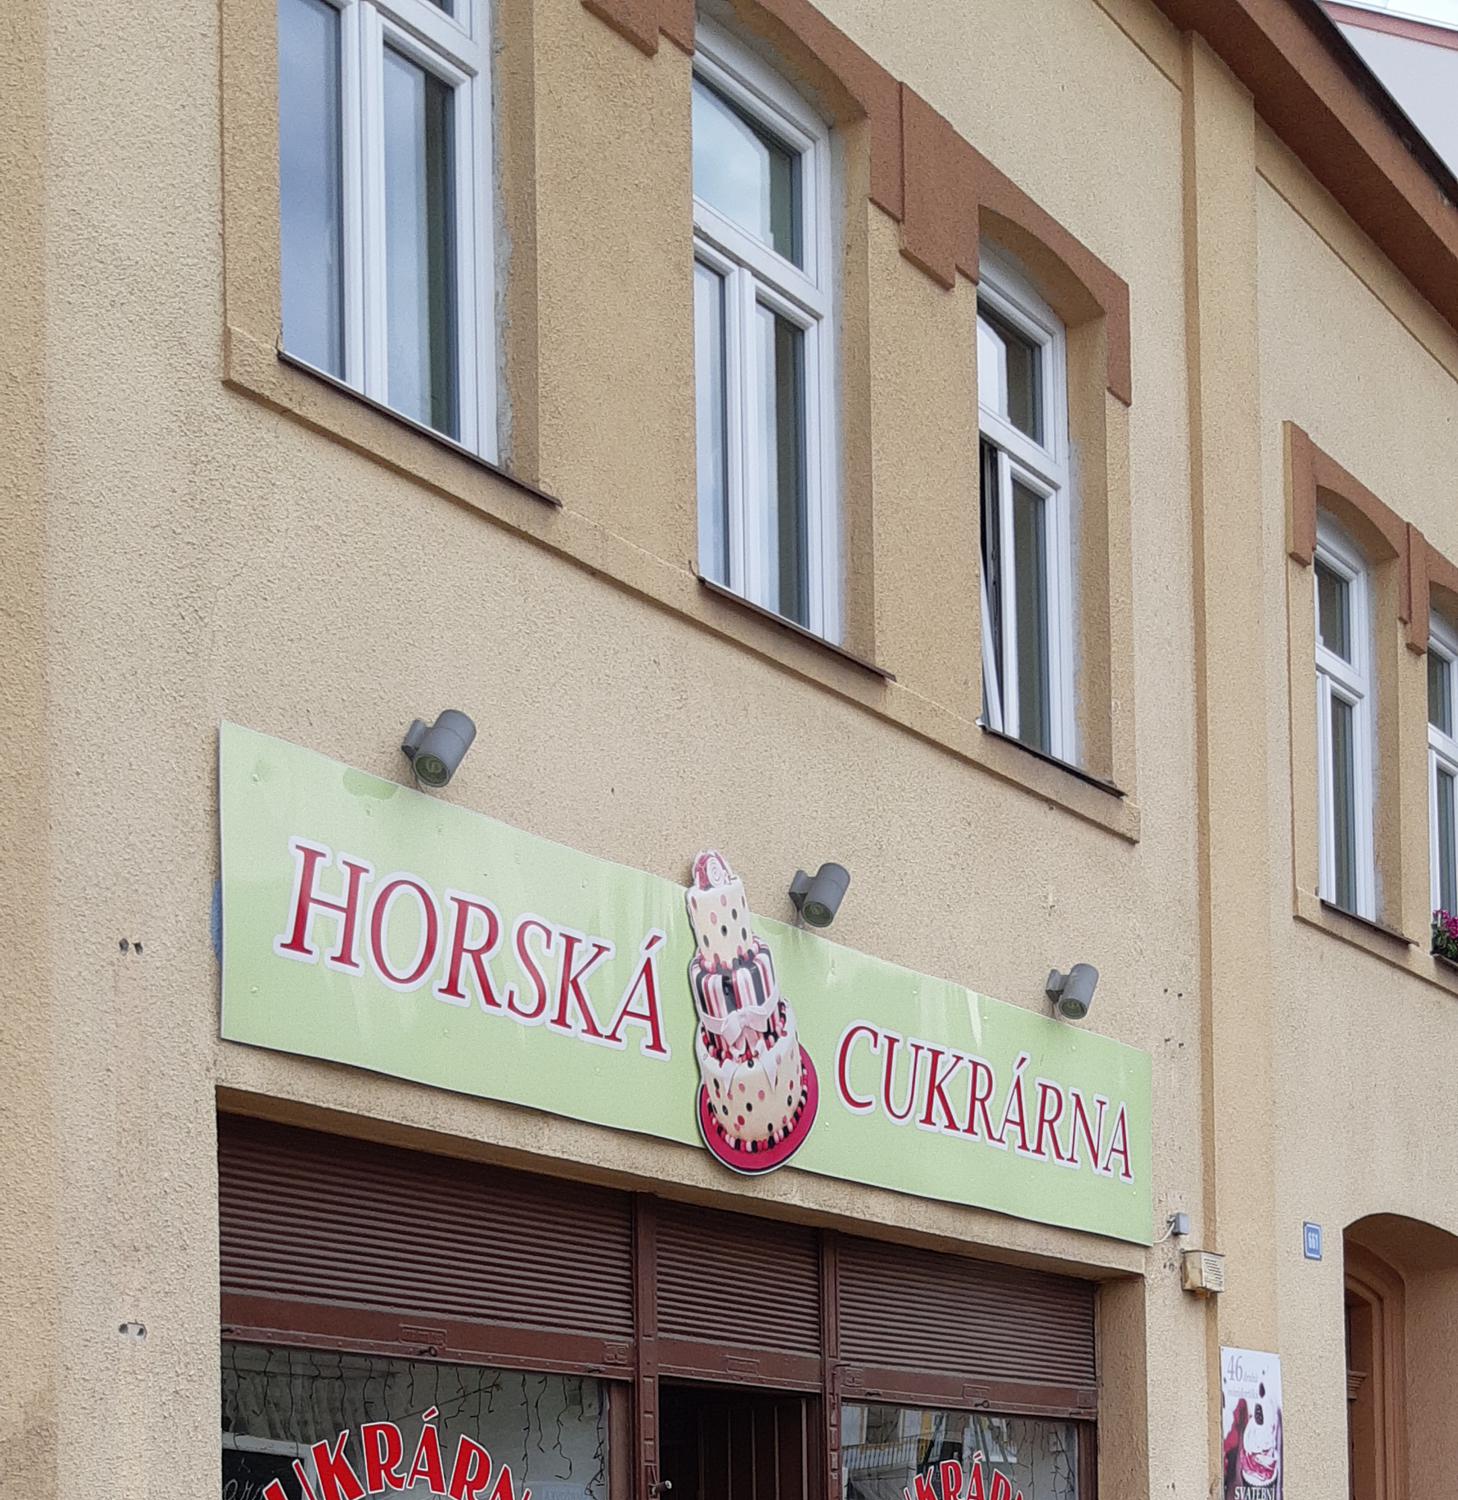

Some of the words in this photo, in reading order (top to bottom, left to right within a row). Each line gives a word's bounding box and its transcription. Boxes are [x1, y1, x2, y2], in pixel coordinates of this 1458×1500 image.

[277, 841, 669, 1058] HORSKÁ
[837, 1024, 1134, 1181] CUKRÁRNA
[1227, 1355, 1243, 1381] 46
[1234, 1484, 1275, 1500] SVATEBNÍ
